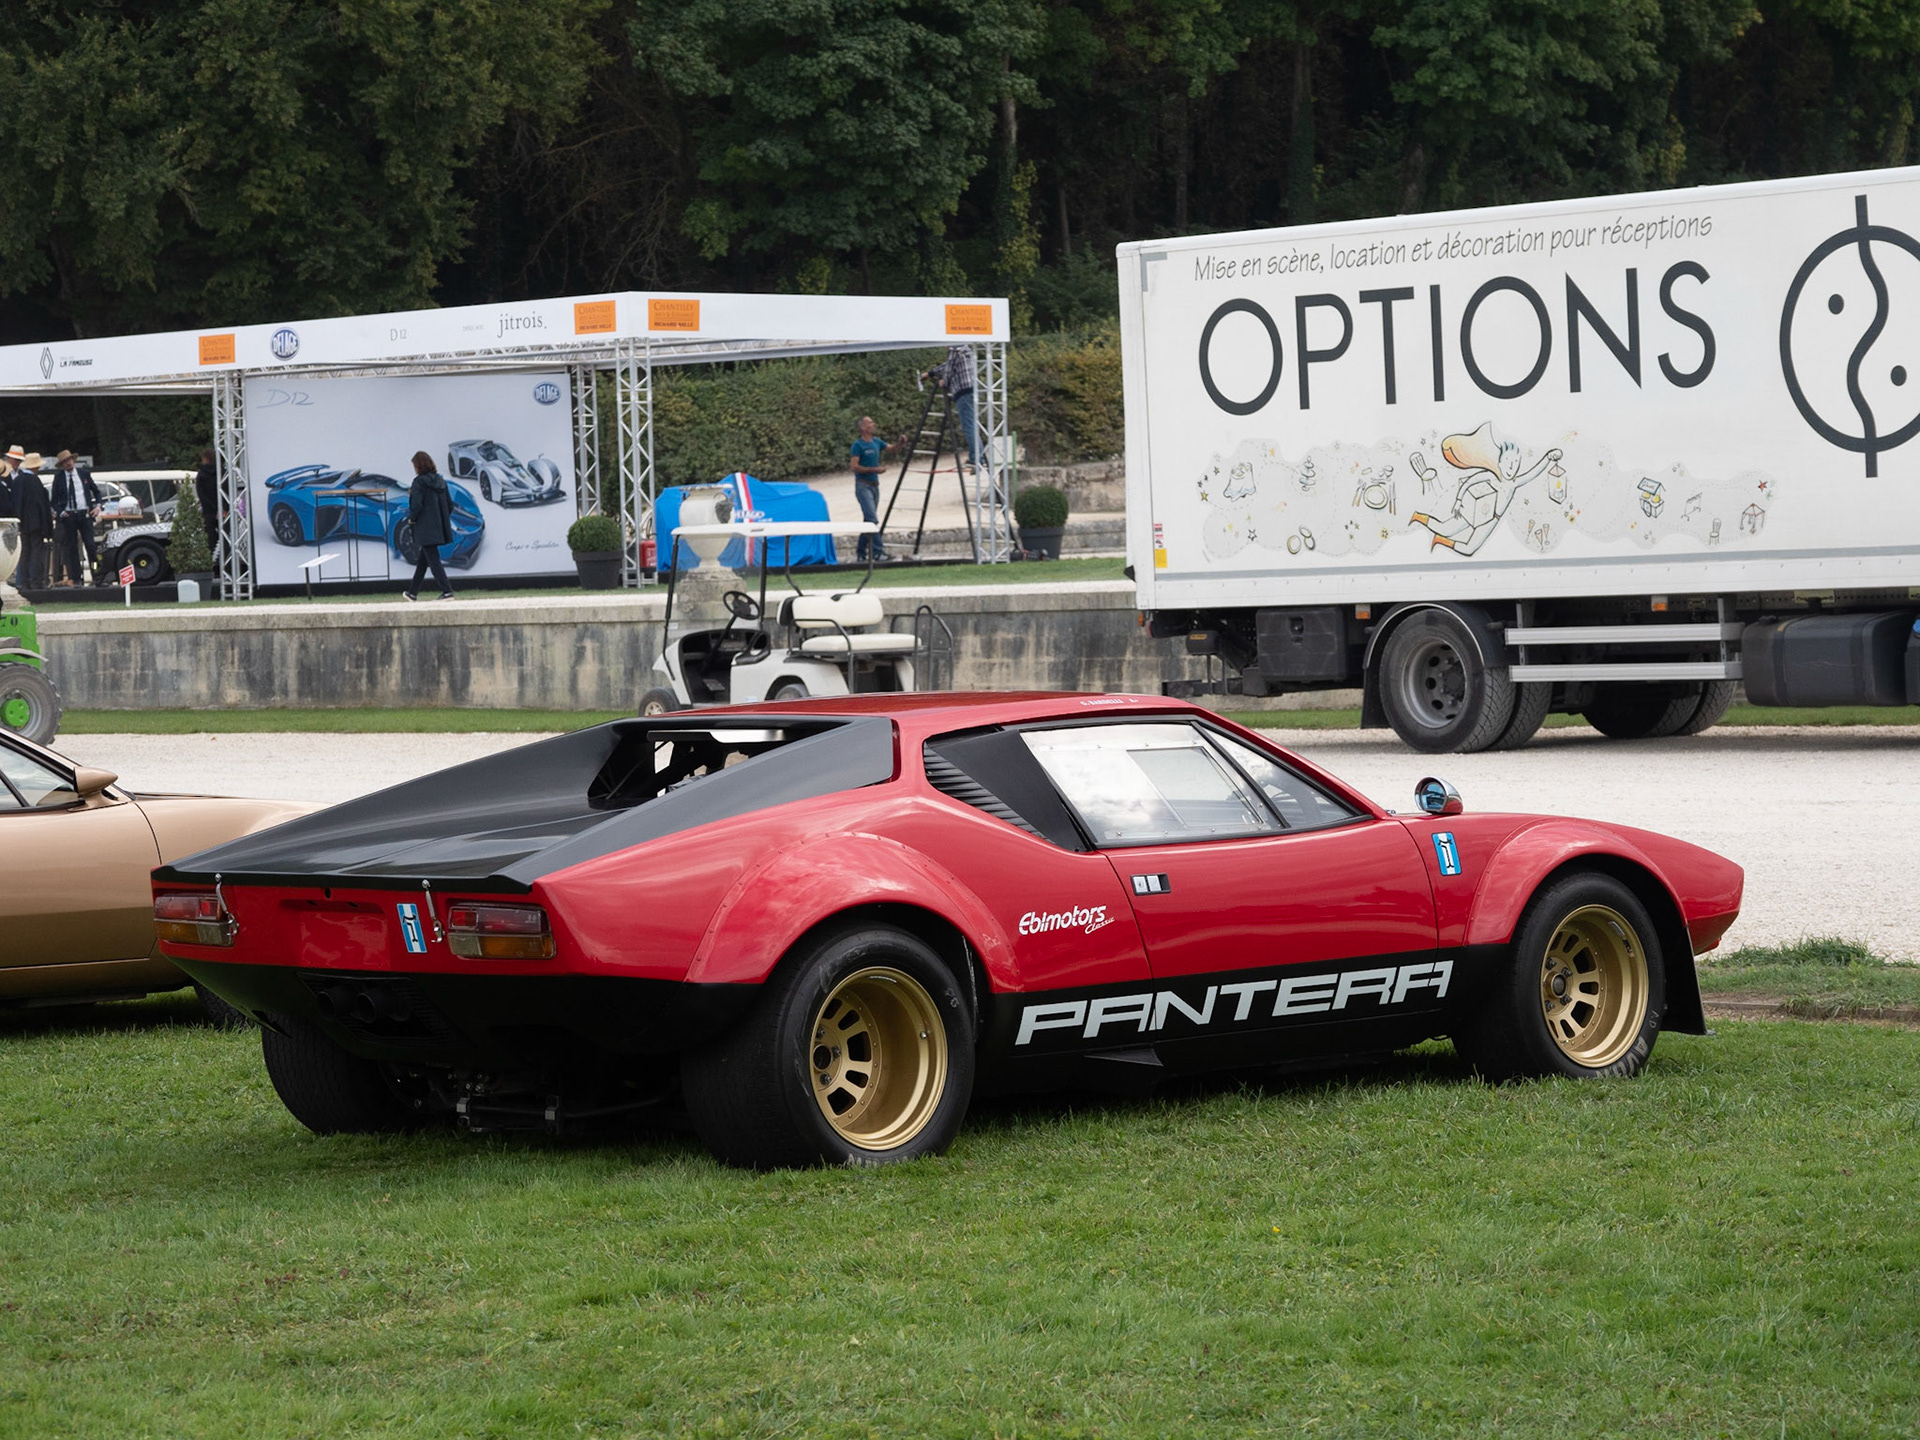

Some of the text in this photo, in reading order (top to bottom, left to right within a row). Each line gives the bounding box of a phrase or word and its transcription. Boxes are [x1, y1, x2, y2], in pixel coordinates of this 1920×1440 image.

[1194, 215, 1712, 281] Mise en scène, location et décoration pour réceptions
[271, 331, 299, 357] DELAGE
[1198, 260, 1716, 416] OPTIONS
[256, 388, 314, 409] D12
[534, 385, 560, 401] DELAGE
[1018, 905, 1107, 936] Ebimotors
[1014, 960, 1454, 1045] PANTERA
